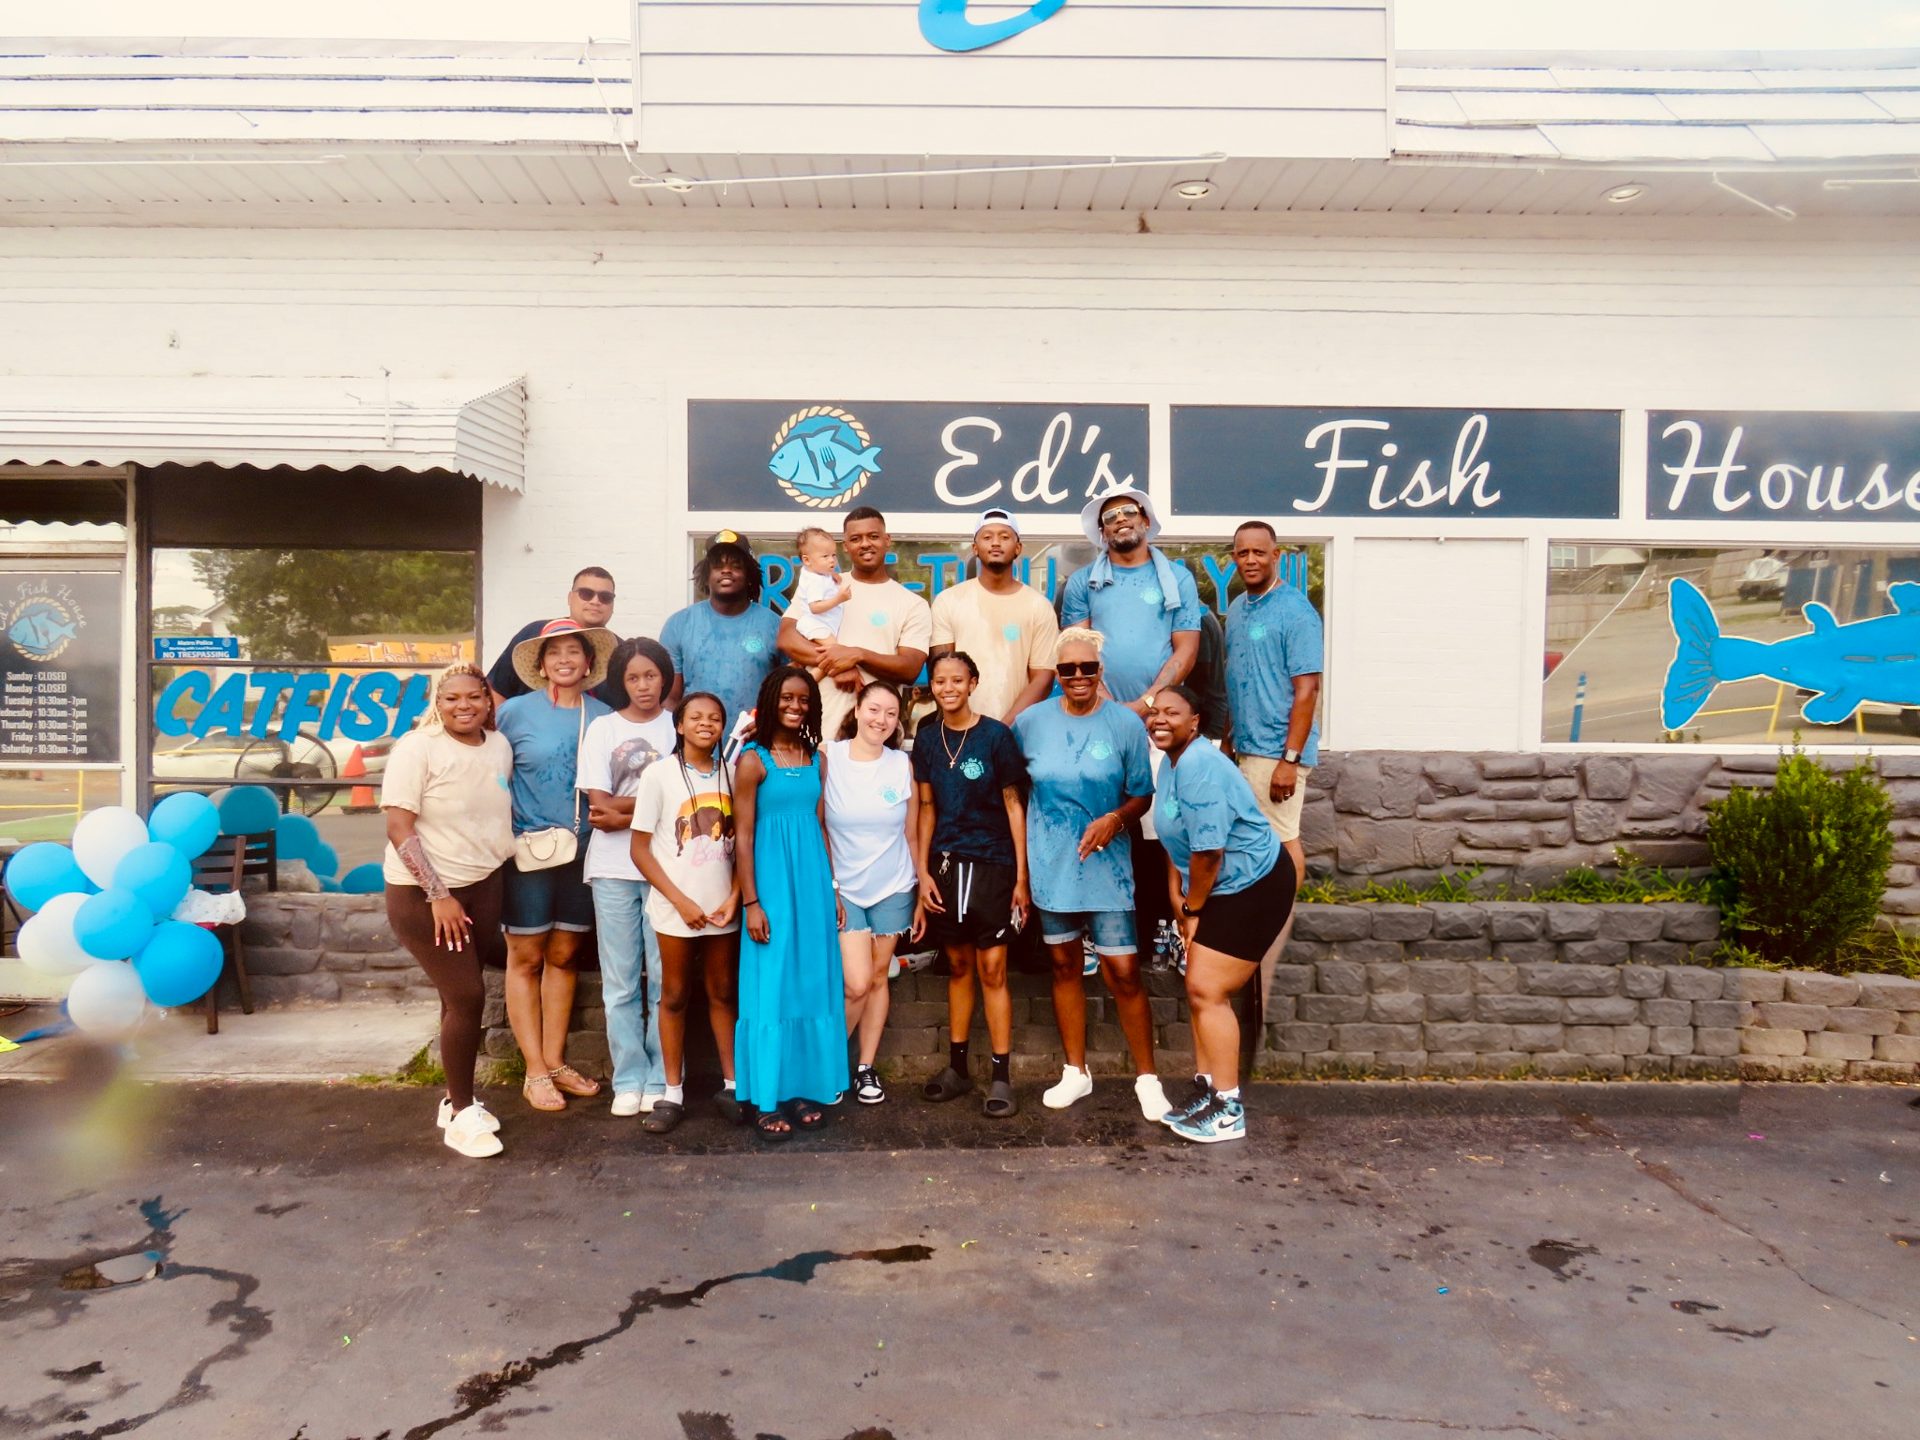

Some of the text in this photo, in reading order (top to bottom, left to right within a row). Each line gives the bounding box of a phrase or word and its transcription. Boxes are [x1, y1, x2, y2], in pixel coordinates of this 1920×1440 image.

[934, 411, 1134, 507] Ed's
[1292, 414, 1501, 512] Fish
[57, 584, 88, 629] House
[162, 651, 230, 659] NO TRESPASSING
[38, 672, 67, 681] CLOSED
[38, 684, 67, 693] CLOSED
